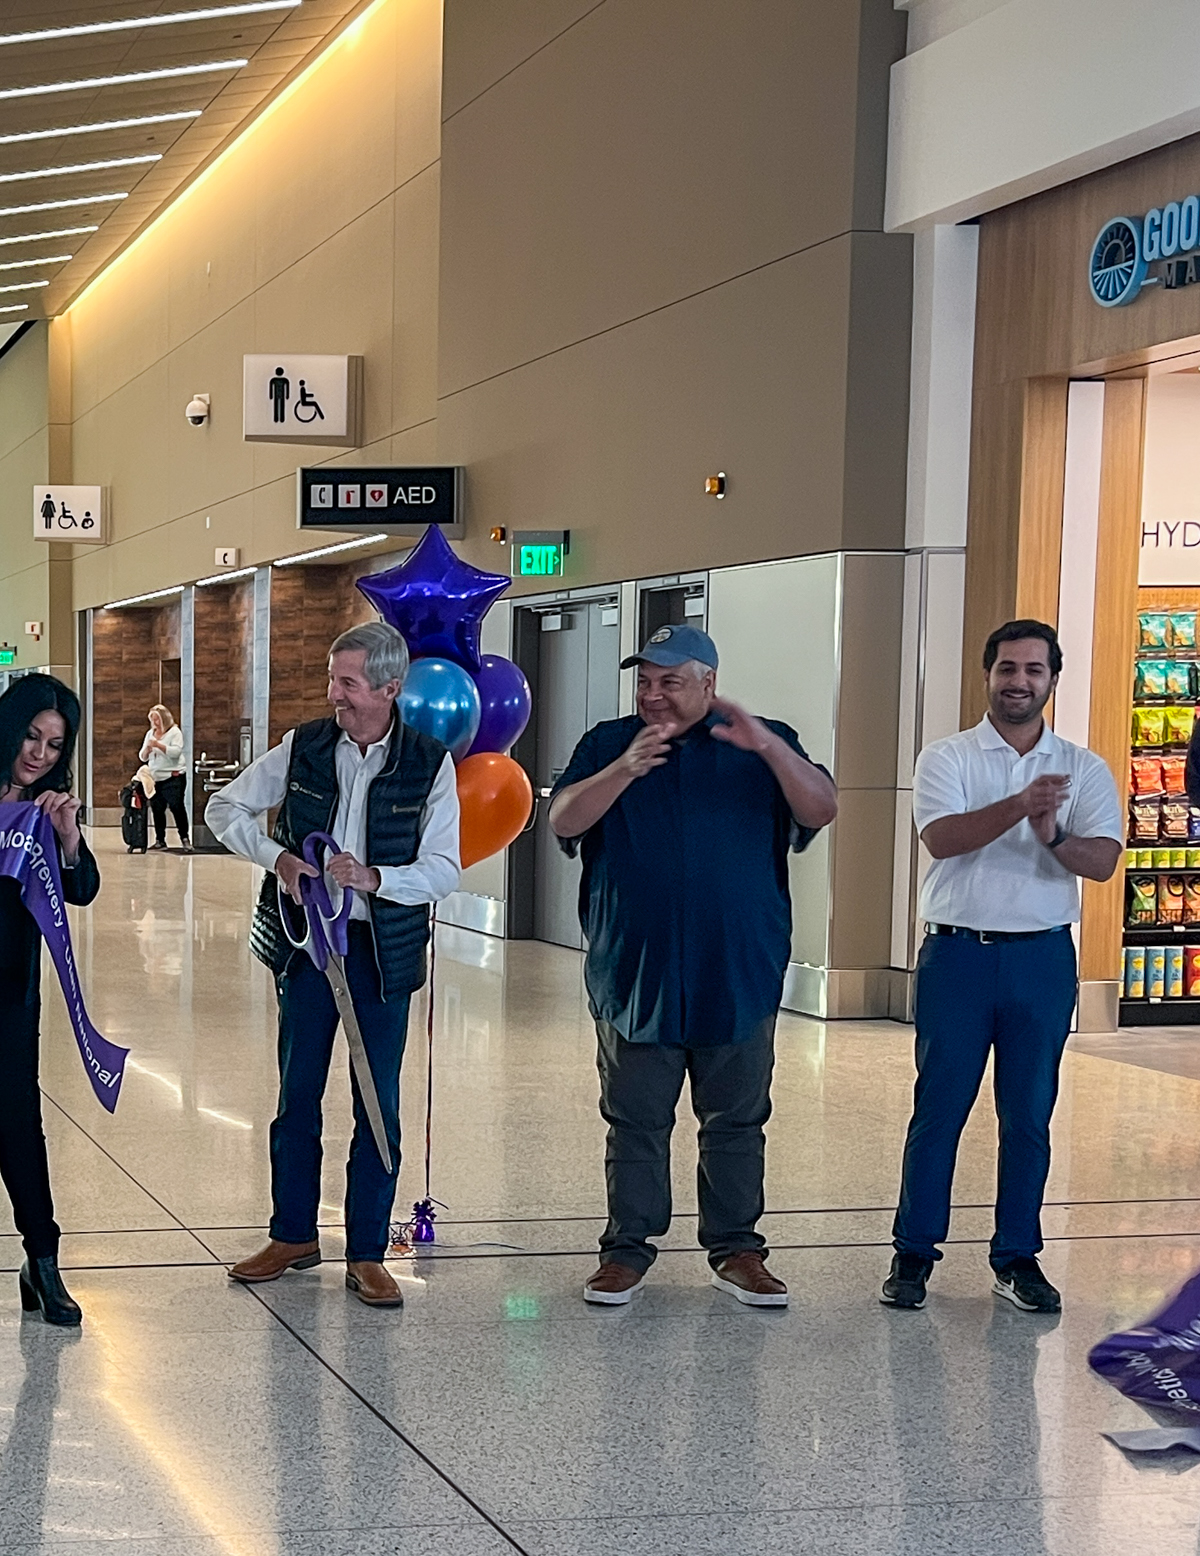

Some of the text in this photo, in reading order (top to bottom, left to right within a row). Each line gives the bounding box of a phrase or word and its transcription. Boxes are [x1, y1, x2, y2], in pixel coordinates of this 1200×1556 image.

[1142, 195, 1200, 262] GOO
[393, 487, 436, 504] AED
[521, 546, 557, 574] EXIT
